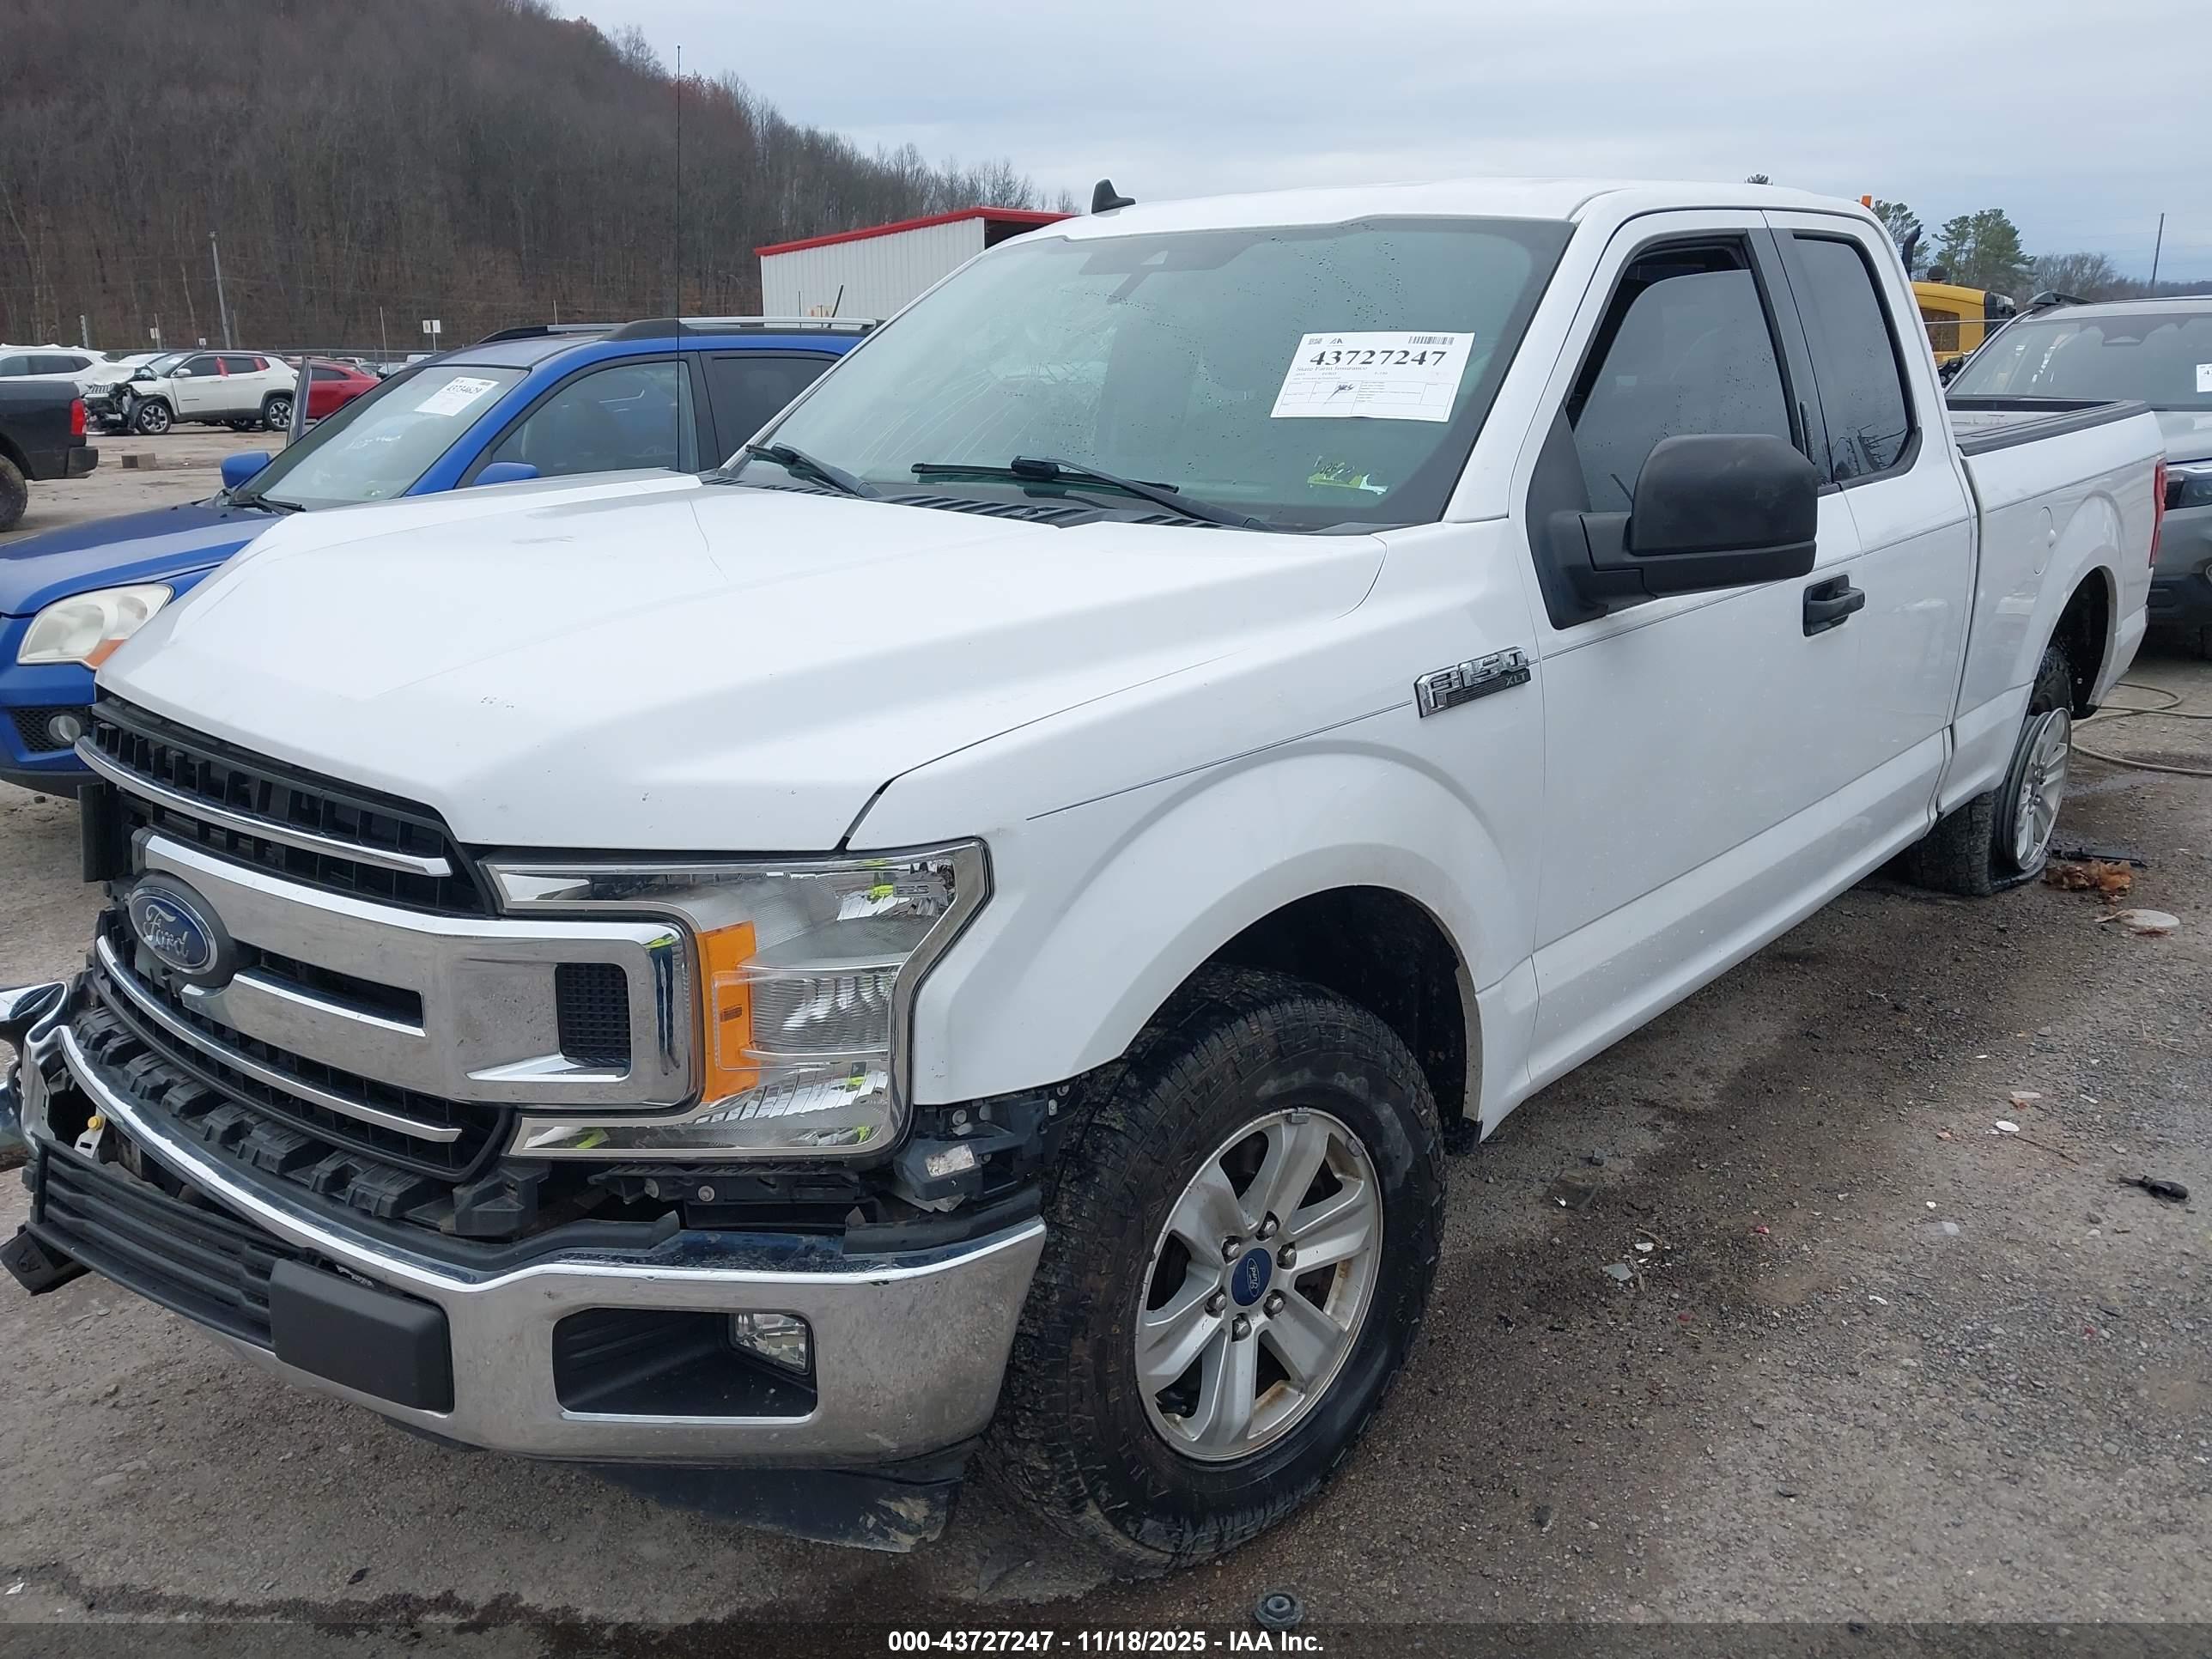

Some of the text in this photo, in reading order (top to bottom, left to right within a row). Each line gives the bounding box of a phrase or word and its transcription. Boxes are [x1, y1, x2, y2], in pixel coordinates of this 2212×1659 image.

[1310, 349, 1447, 366] 43727247
[1505, 672, 1527, 687] XLT
[143, 904, 189, 957] Ford
